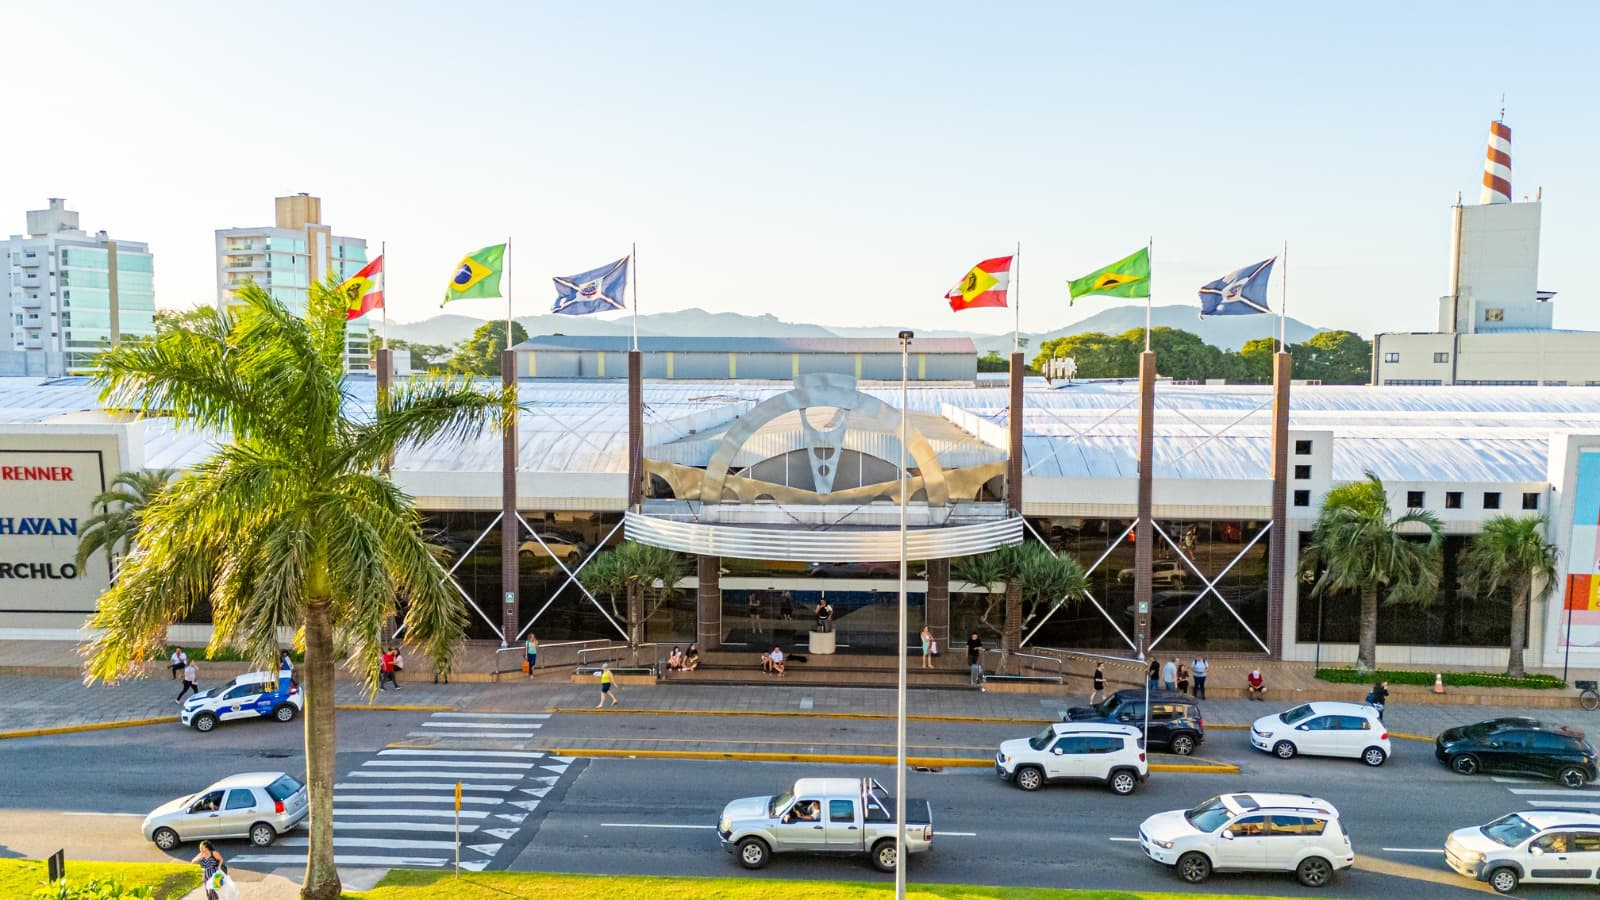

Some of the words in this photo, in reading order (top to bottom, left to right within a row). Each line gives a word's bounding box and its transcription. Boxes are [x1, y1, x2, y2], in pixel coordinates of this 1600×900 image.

[1, 466, 74, 481] RENNER
[0, 517, 78, 535] HAVAN
[0, 562, 78, 579] RCHLO
